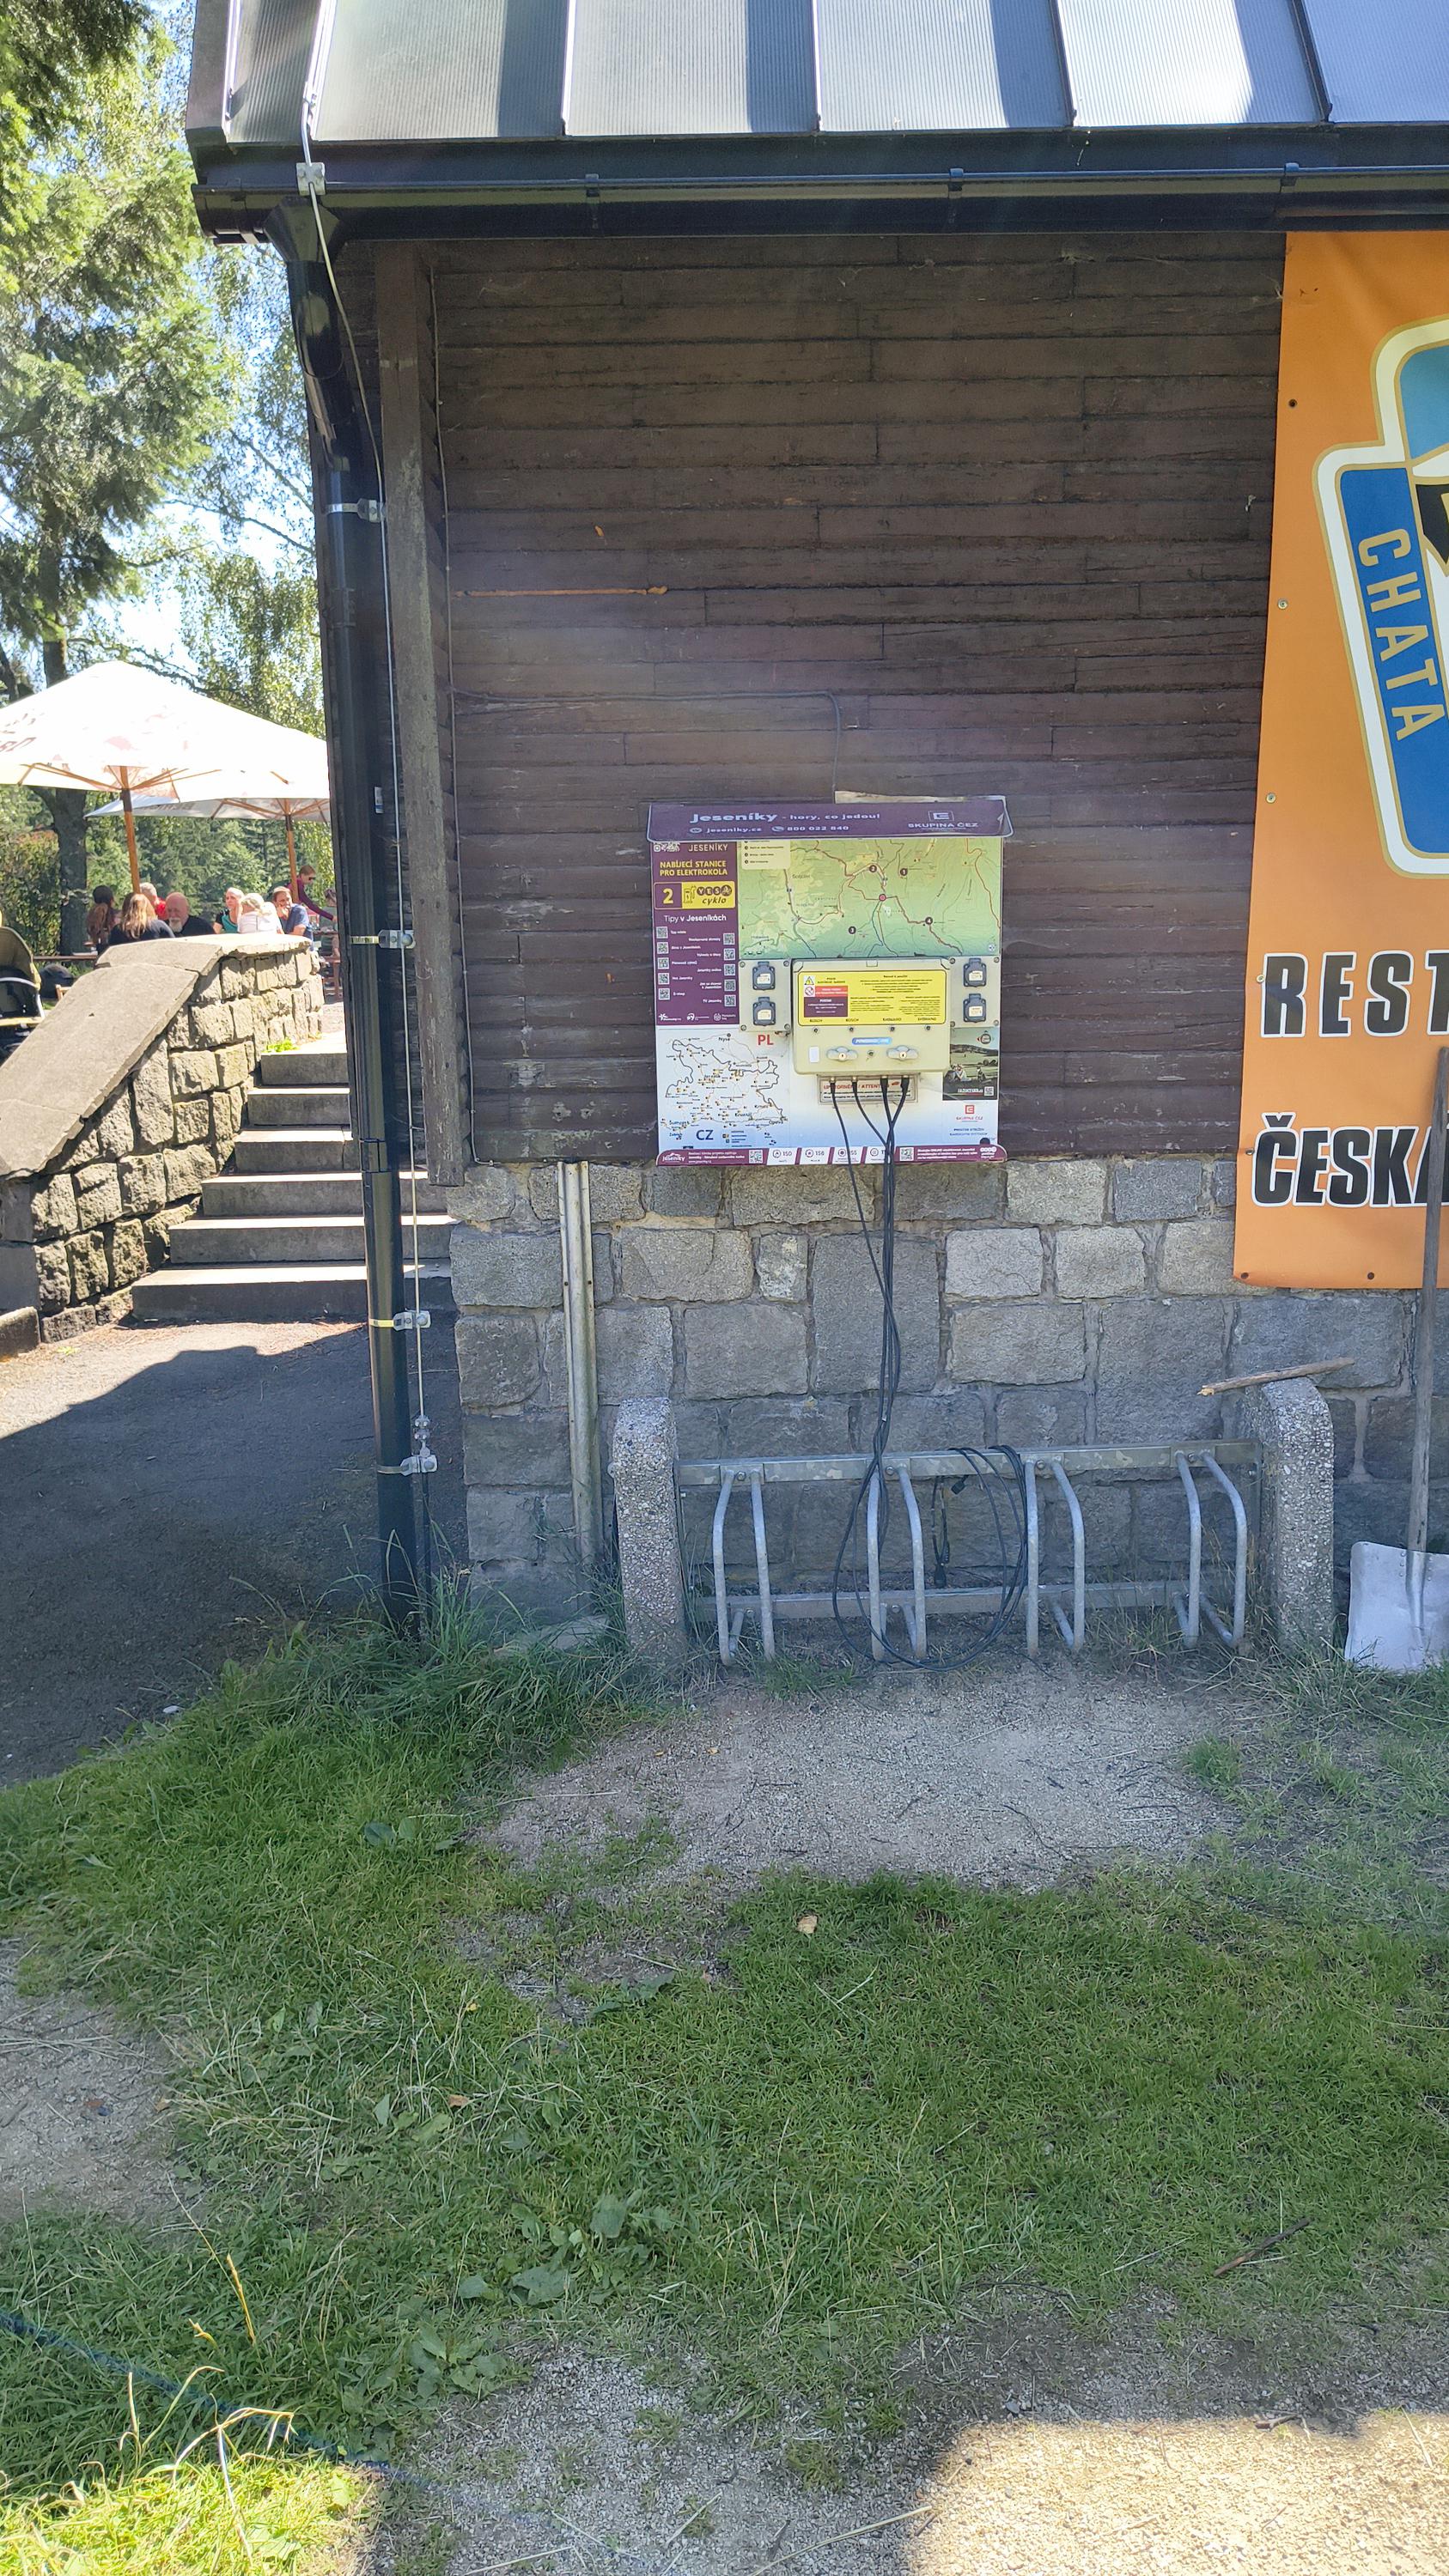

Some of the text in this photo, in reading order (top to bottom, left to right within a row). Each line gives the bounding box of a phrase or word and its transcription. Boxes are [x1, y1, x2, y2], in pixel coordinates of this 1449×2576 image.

[1358, 528, 1445, 741] CHATA
[690, 812, 777, 823] Jeseníky
[688, 842, 728, 852] JESENÍKY
[660, 860, 693, 868] NABÍJECÍ
[662, 888, 674, 904] 2
[702, 896, 727, 904] cyklo
[1261, 951, 1449, 1037] REST
[758, 1034, 774, 1046] PL
[696, 1130, 714, 1140] CZ
